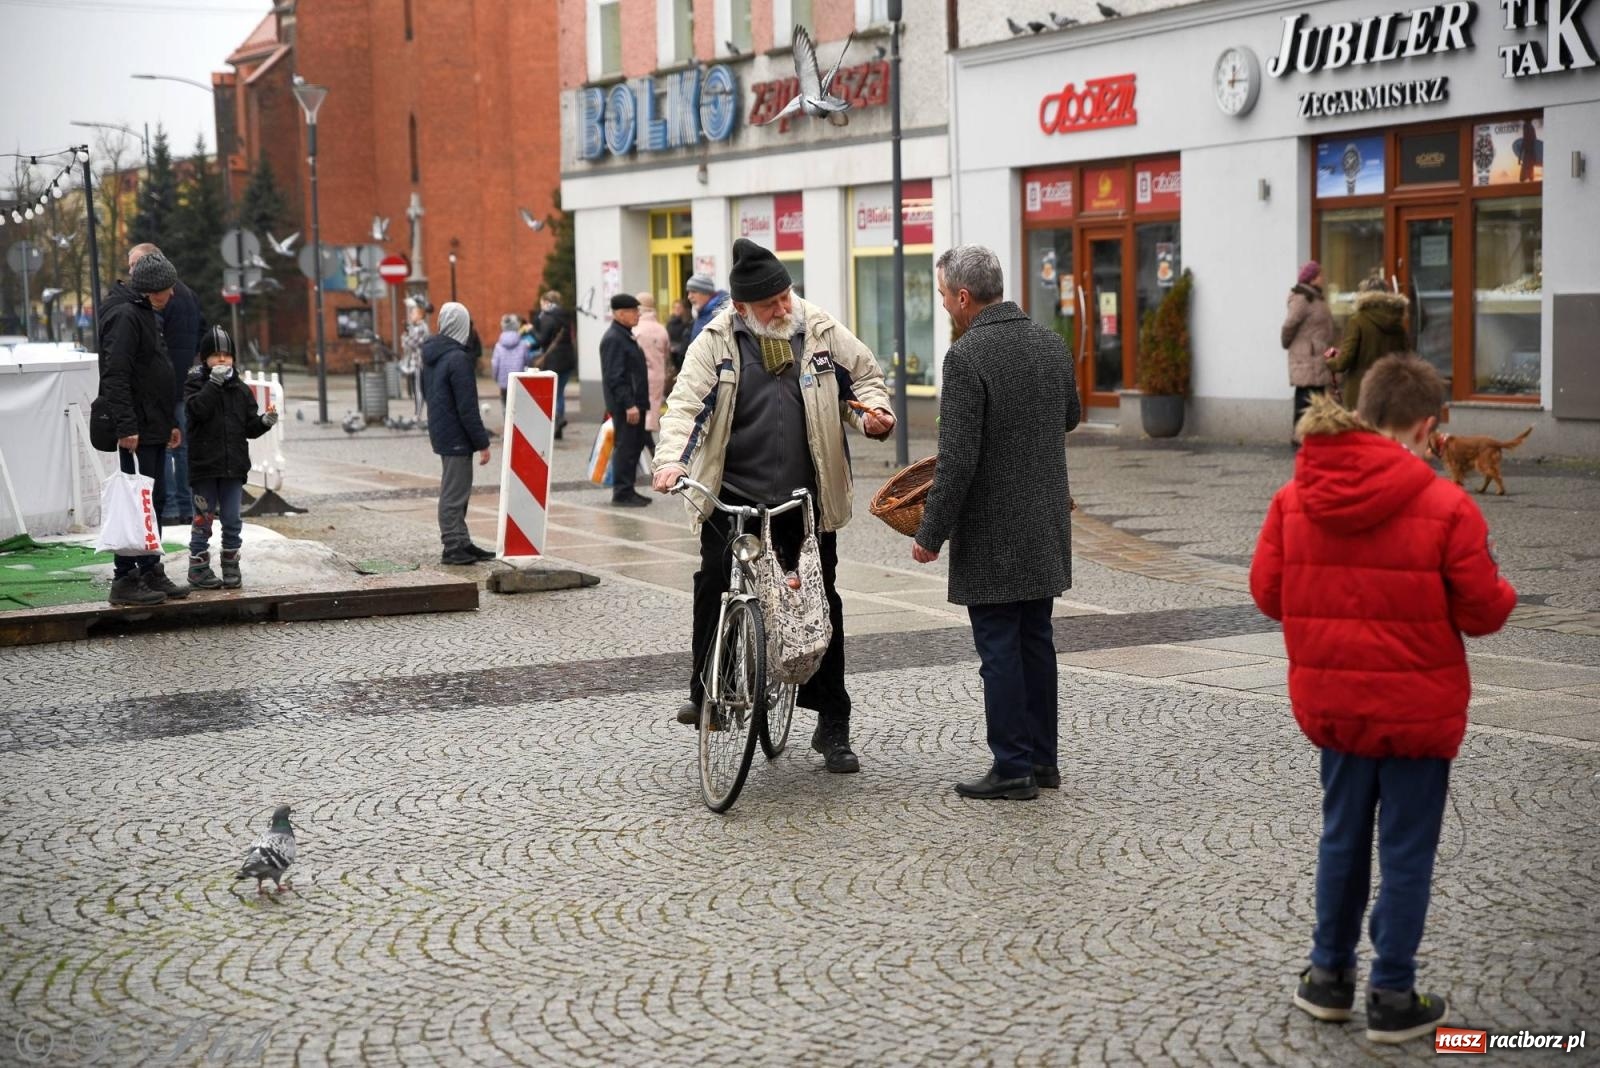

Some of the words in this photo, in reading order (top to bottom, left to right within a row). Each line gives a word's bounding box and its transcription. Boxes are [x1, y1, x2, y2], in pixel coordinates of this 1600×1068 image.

[1266, 1, 1474, 78] JUBILER
[578, 64, 737, 160] BOLKO
[749, 60, 890, 133] zapsza
[1299, 77, 1448, 119] ZEGARMISTRZ
